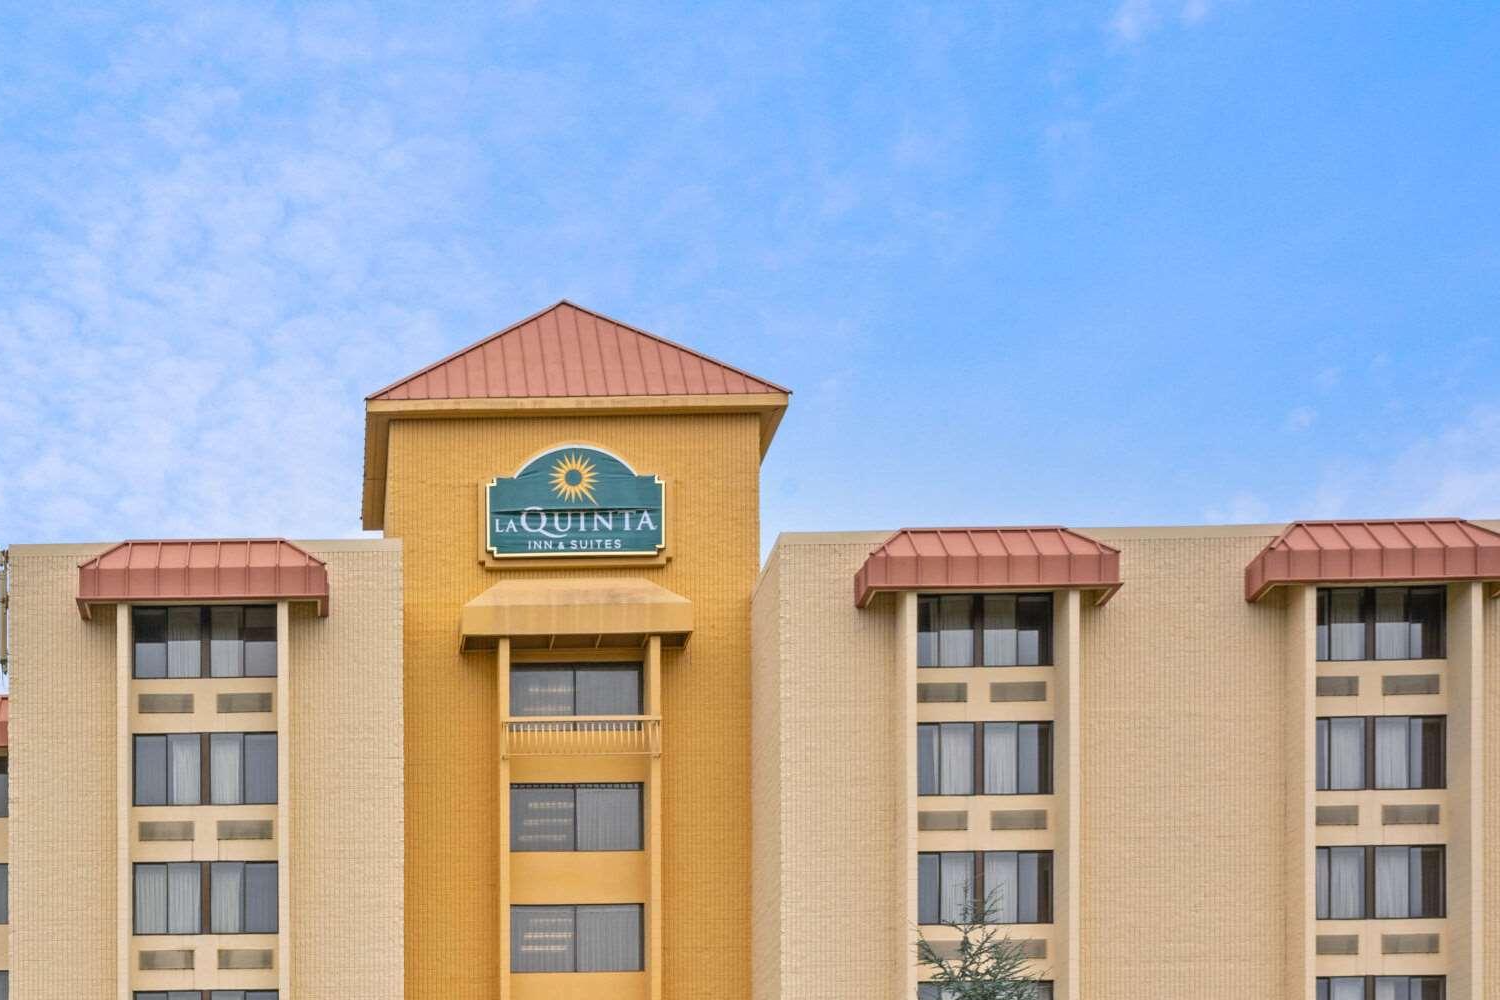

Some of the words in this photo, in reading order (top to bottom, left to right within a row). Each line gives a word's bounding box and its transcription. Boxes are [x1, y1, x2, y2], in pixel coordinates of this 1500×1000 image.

[495, 518, 518, 533] LA
[520, 506, 658, 538] QUINTA
[528, 540, 553, 550] INN
[557, 541, 565, 550] &
[570, 539, 622, 550] SUITES
